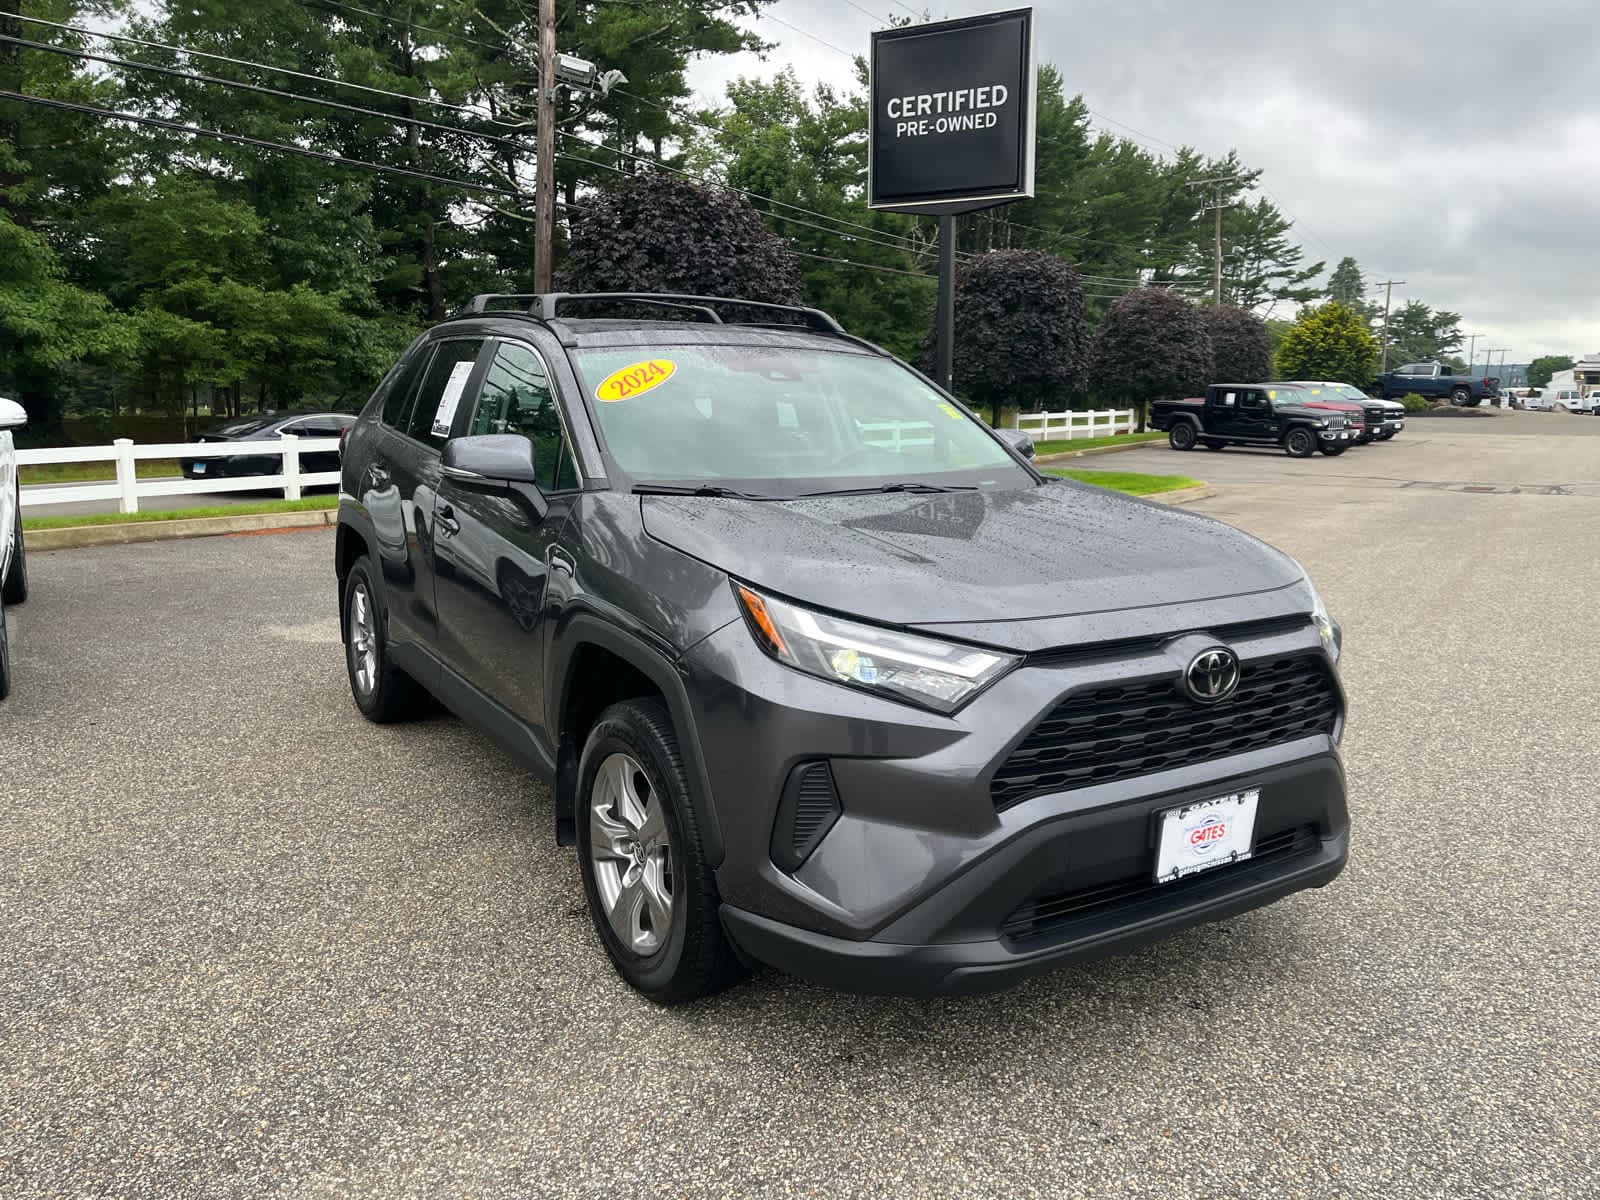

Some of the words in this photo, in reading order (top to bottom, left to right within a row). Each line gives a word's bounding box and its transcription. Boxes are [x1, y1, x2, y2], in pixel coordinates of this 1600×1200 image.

[887, 85, 1008, 119] CERTIFIED
[896, 112, 997, 138] PRE-OWNED
[610, 362, 666, 397] 2024
[1190, 824, 1225, 844] GATES
